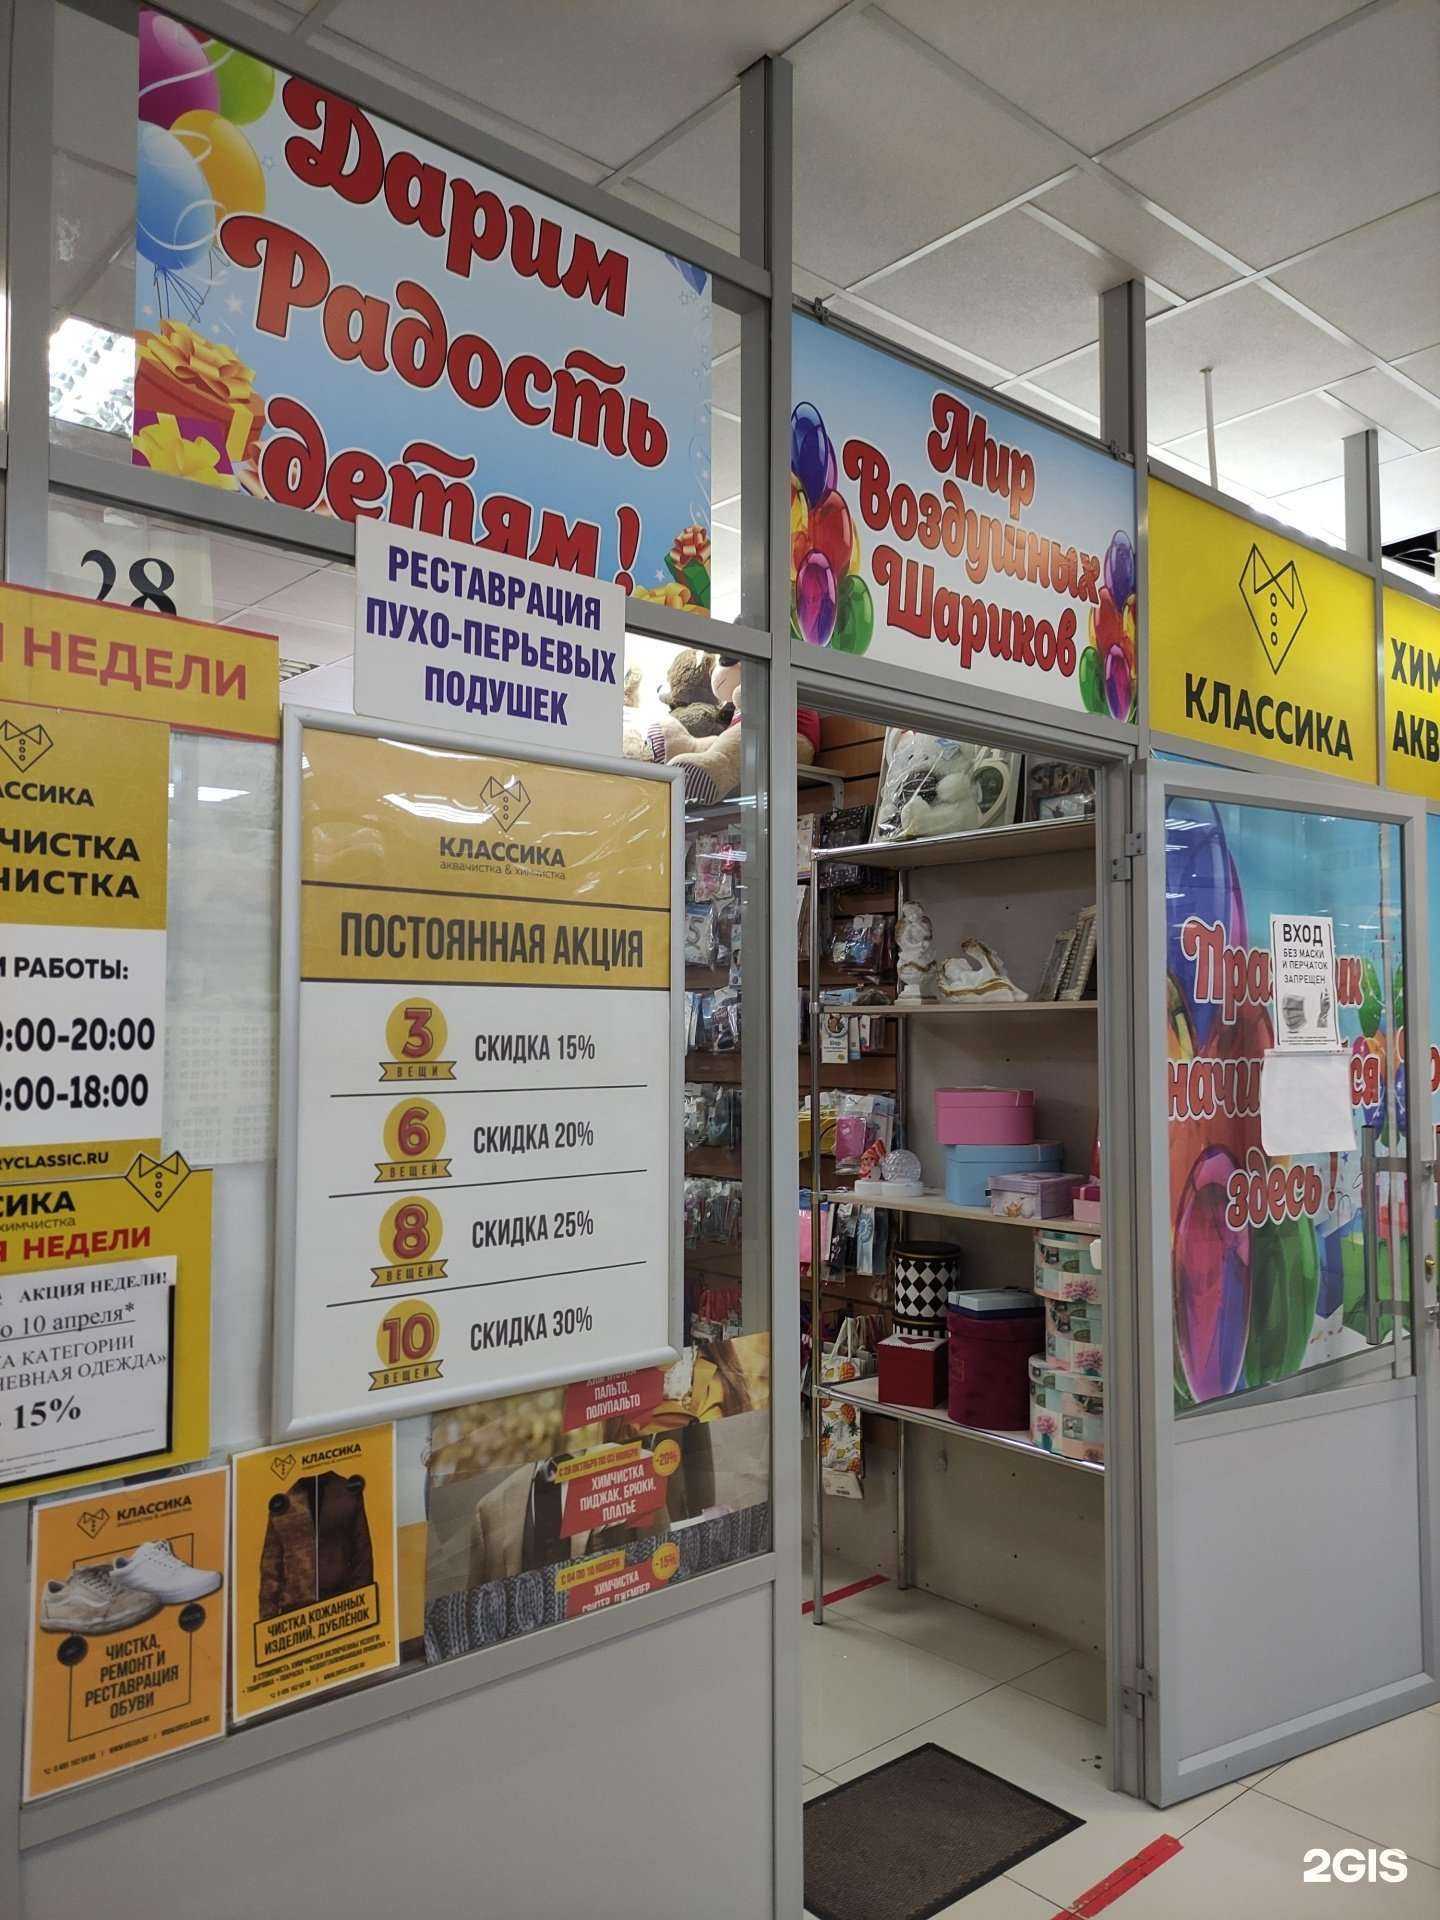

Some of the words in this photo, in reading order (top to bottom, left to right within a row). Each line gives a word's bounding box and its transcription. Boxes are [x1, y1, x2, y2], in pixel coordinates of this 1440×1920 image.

[282, 77, 629, 316] Дарим
[220, 215, 669, 470] Радость
[928, 393, 1035, 520] Мир
[843, 439, 1099, 604] Воздушных
[388, 545, 601, 631] РЕСТАВРАЦИЯ
[872, 545, 1077, 677] Шариков
[366, 597, 617, 684] ПУХО-ПЕРЬЕВЫХ
[24, 627, 247, 700] НЕДЕЛИ
[425, 666, 568, 726] ПОДУШЕК
[1186, 672, 1353, 761] КЛАССИКА
[1392, 710, 1440, 762] АКВ
[0, 781, 95, 808] ССИКА
[440, 836, 565, 868] КЛАССИКА
[440, 861, 502, 874] аквачистка
[504, 864, 512, 875] &
[341, 911, 545, 964] ПОСТОЯННАЯ
[553, 925, 643, 971] АКЦИЯ
[1283, 923, 1323, 947] ВХОД
[14, 957, 129, 980] РАБОТЫ:
[1282, 960, 1288, 969] И
[1289, 960, 1328, 970] ПЕРЧАТОК
[1283, 948, 1298, 958] БЕЗ
[1300, 949, 1325, 959] МАСКИ
[1283, 974, 1326, 985] ЗАПРЕЩЕН
[0, 1017, 155, 1052] :00-20:00
[401, 1008, 434, 1059] 3
[475, 1034, 551, 1064] СКИДКА
[557, 1034, 596, 1061] 15%
[397, 1064, 439, 1078] ВЕЩИ
[0, 1073, 149, 1112] :00-18:00
[398, 1106, 431, 1156] 6
[474, 1123, 549, 1154] СКИДКА
[555, 1120, 594, 1149] 20%
[0, 1152, 109, 1171] YCLASSIC.RU
[389, 1164, 438, 1179] ВЕЩЕЙ
[0, 1190, 76, 1217] ИКА
[24, 1226, 151, 1260] НЕДЕЛИ
[393, 1204, 431, 1260] 8
[472, 1214, 548, 1249] СКИДКА
[553, 1209, 594, 1239] 25%
[19, 1281, 85, 1303] АКЦИЯ
[90, 1271, 168, 1294] НЕДЕЛИ!
[386, 1263, 434, 1282] ВЕЩЕЙ
[23, 1314, 46, 1335] 10
[382, 1312, 435, 1365] 10
[470, 1312, 547, 1351] СКИДКА
[552, 1306, 593, 1338] 30%
[22, 1334, 134, 1367] КАТЕГОРИИ
[0, 1365, 72, 1392] ЕВНАЯ
[78, 1352, 167, 1379] ОДЕЖДА»
[383, 1366, 430, 1385] ВЕЩЕЙ
[15, 1395, 81, 1430] 15%
[586, 1393, 641, 1420] ПОЛУПАЛЬТО
[301, 1442, 363, 1466] КЛАССИКА
[592, 1464, 645, 1491] ХИМЧИСТКА
[116, 1494, 193, 1521] КЛАССИКА
[602, 1499, 637, 1521] ПЛАТЬЕ
[594, 1570, 640, 1596] ХИМЧИСТКА
[268, 1613, 307, 1637] ЧИСТКА
[308, 1592, 367, 1623] КОЖАННЫХ
[100, 1652, 154, 1682] РЕМОНТ
[157, 1650, 165, 1665] И
[84, 1664, 179, 1708] РЕСТАВРАЦИЯ
[110, 1691, 155, 1719] ОБУВИ
